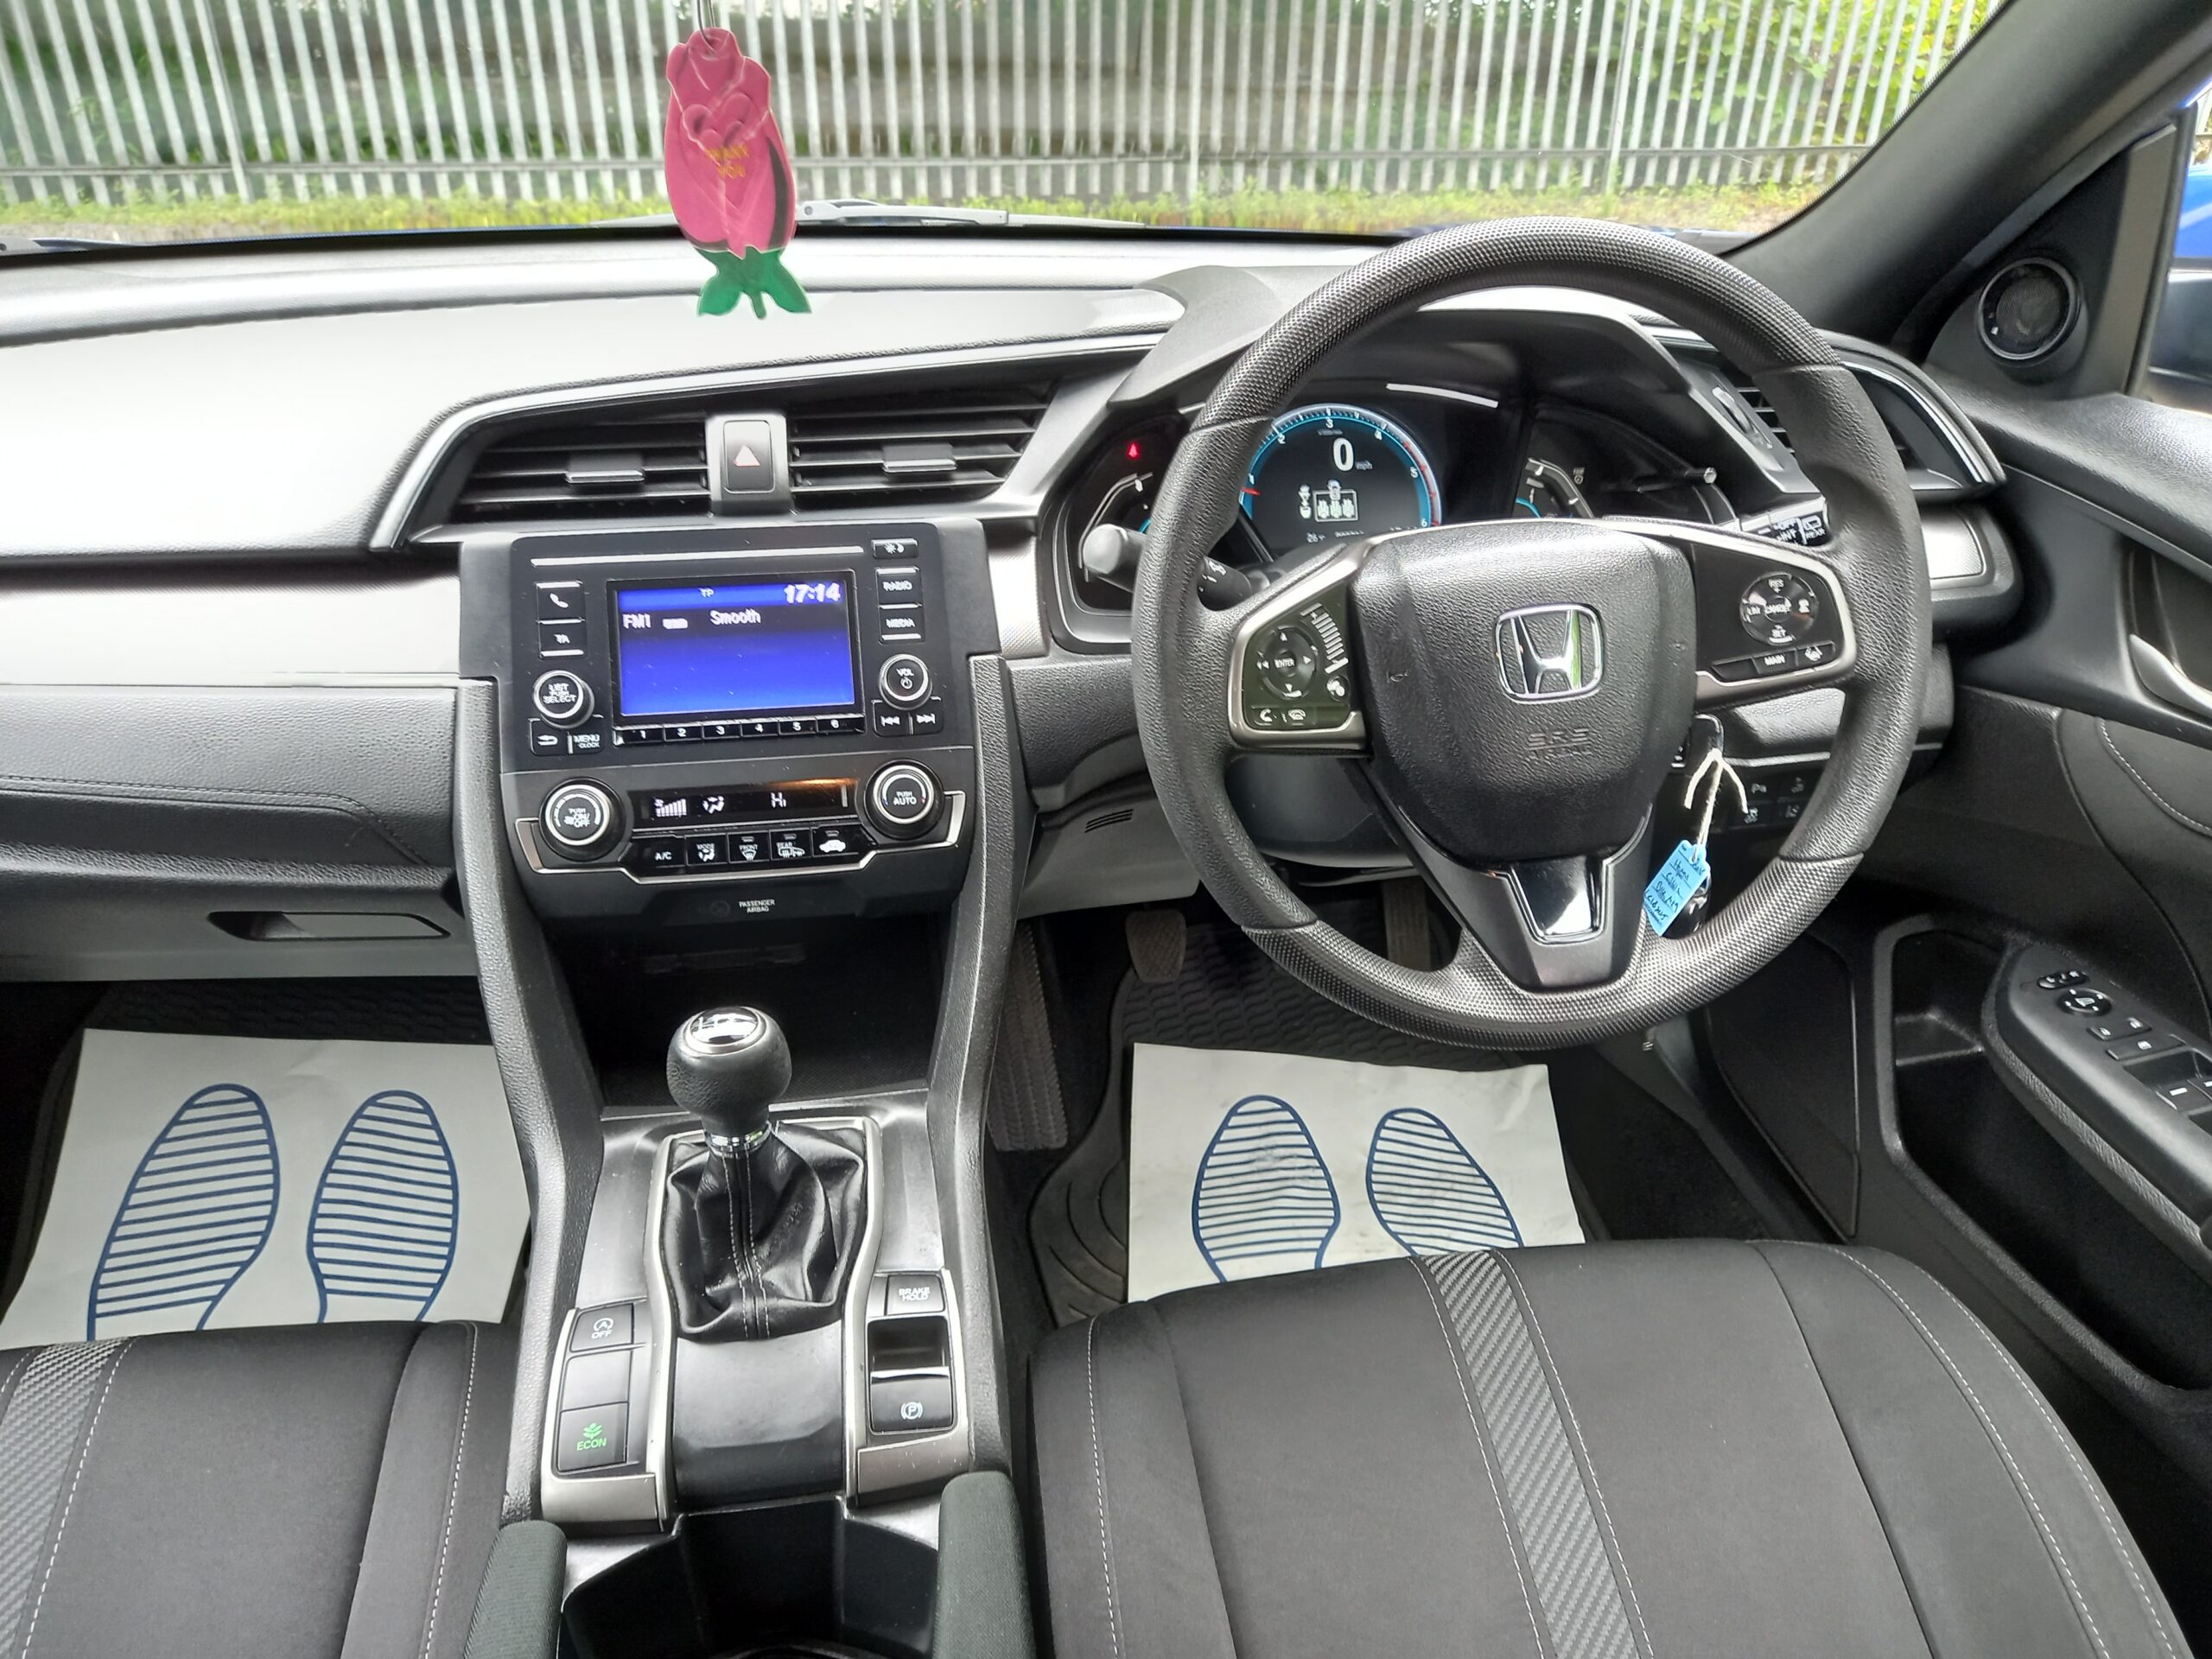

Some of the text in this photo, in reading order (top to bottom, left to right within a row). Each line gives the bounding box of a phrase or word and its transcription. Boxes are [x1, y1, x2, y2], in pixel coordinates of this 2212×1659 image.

[1325, 418, 1333, 429] 3
[1277, 433, 1286, 445] 2
[1333, 437, 1354, 472] 0
[1409, 467, 1418, 478] 5
[1421, 518, 1428, 528] 6
[882, 580, 913, 592] RADIO
[784, 582, 841, 604] 17:14
[622, 613, 652, 629] FM1
[710, 608, 761, 626] Smooth
[886, 617, 916, 629] MEDIA
[1274, 658, 1295, 669] ENTER
[1764, 654, 1785, 666] MAIN
[896, 667, 915, 677] VOL
[543, 694, 576, 704] SELECT
[754, 723, 764, 733] 4
[792, 721, 802, 731] 5
[830, 719, 840, 728] 6
[640, 729, 646, 739] 1
[677, 728, 687, 737] 2
[716, 725, 726, 734] 3
[572, 734, 601, 744] MENU
[893, 797, 918, 806] AUTO
[654, 851, 673, 861] A/C
[739, 899, 775, 907] PASSENGER
[899, 1287, 931, 1296] BRAKE
[902, 1293, 929, 1301] HOLD
[591, 1330, 613, 1339] OFF
[576, 1437, 607, 1452] ECON
